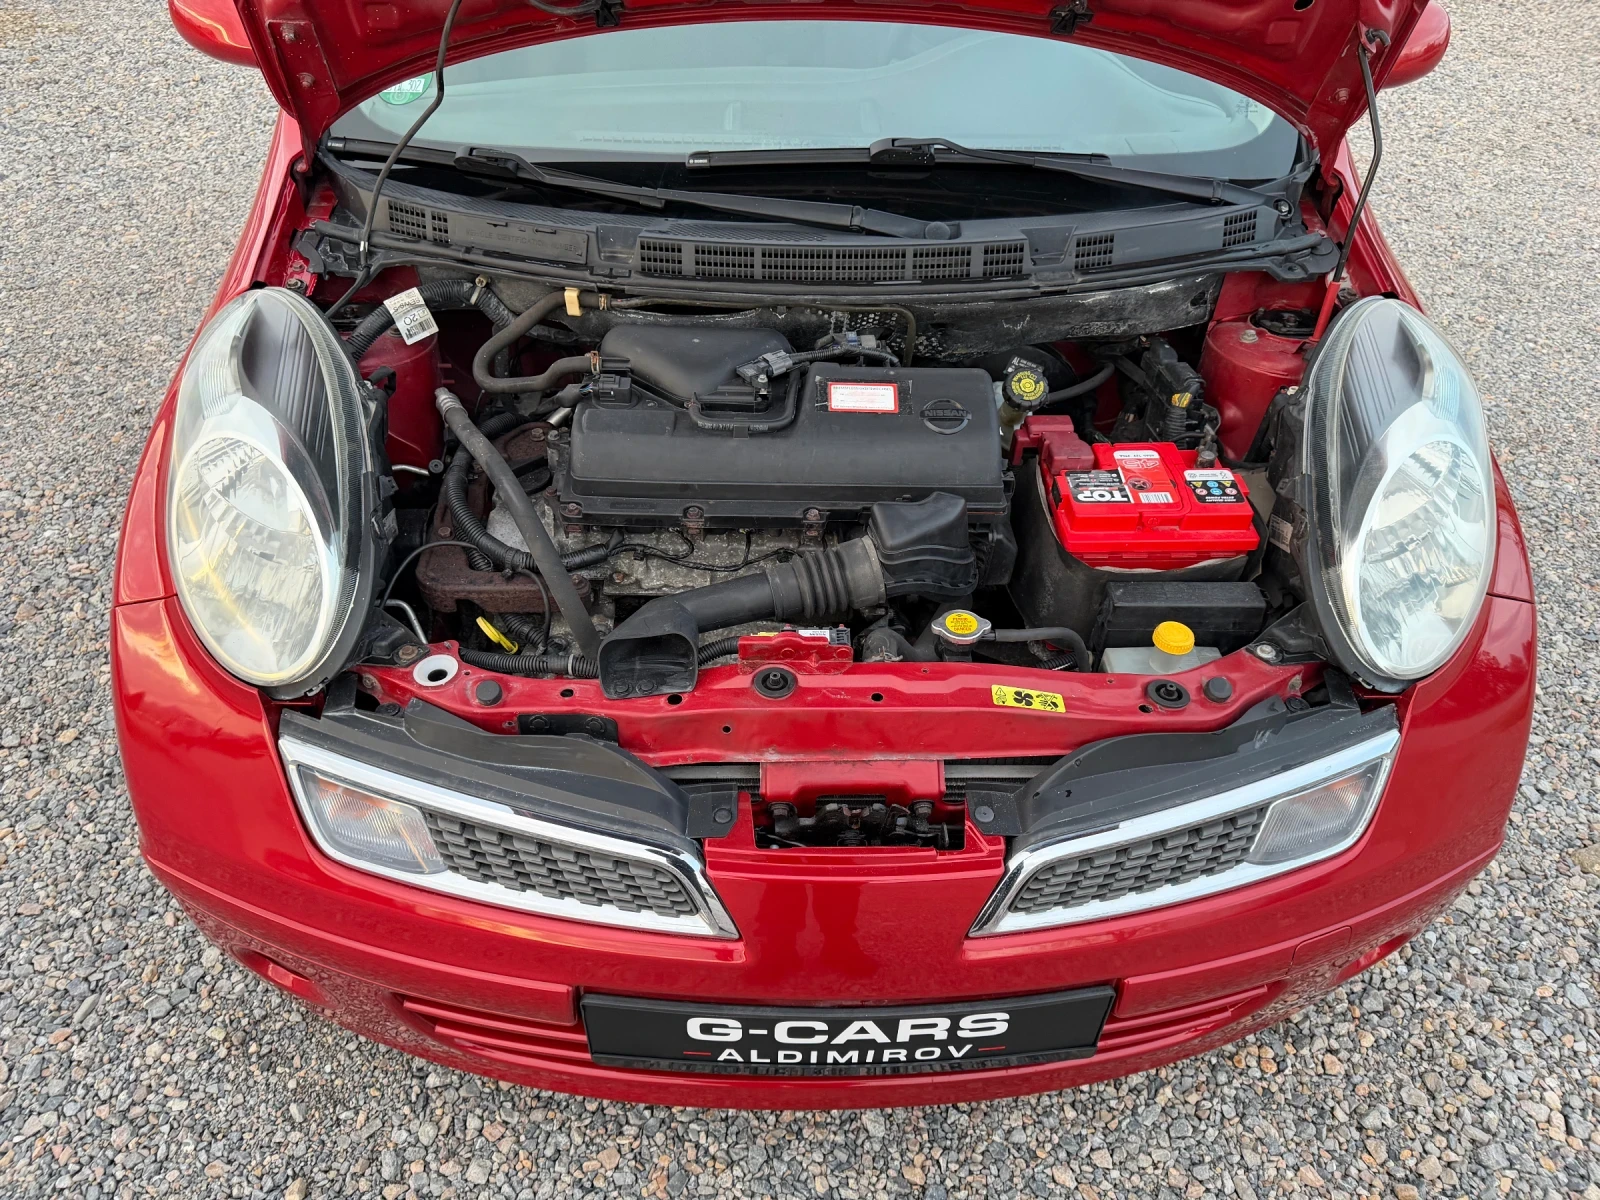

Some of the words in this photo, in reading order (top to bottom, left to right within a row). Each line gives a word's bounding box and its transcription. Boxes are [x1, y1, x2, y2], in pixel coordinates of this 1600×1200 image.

[924, 409, 967, 417] NISSAN
[1122, 459, 1159, 469] 45
[1077, 490, 1129, 502] TOP
[686, 1012, 1010, 1045] G-CARS
[716, 1044, 973, 1064] ALDIMIROV
